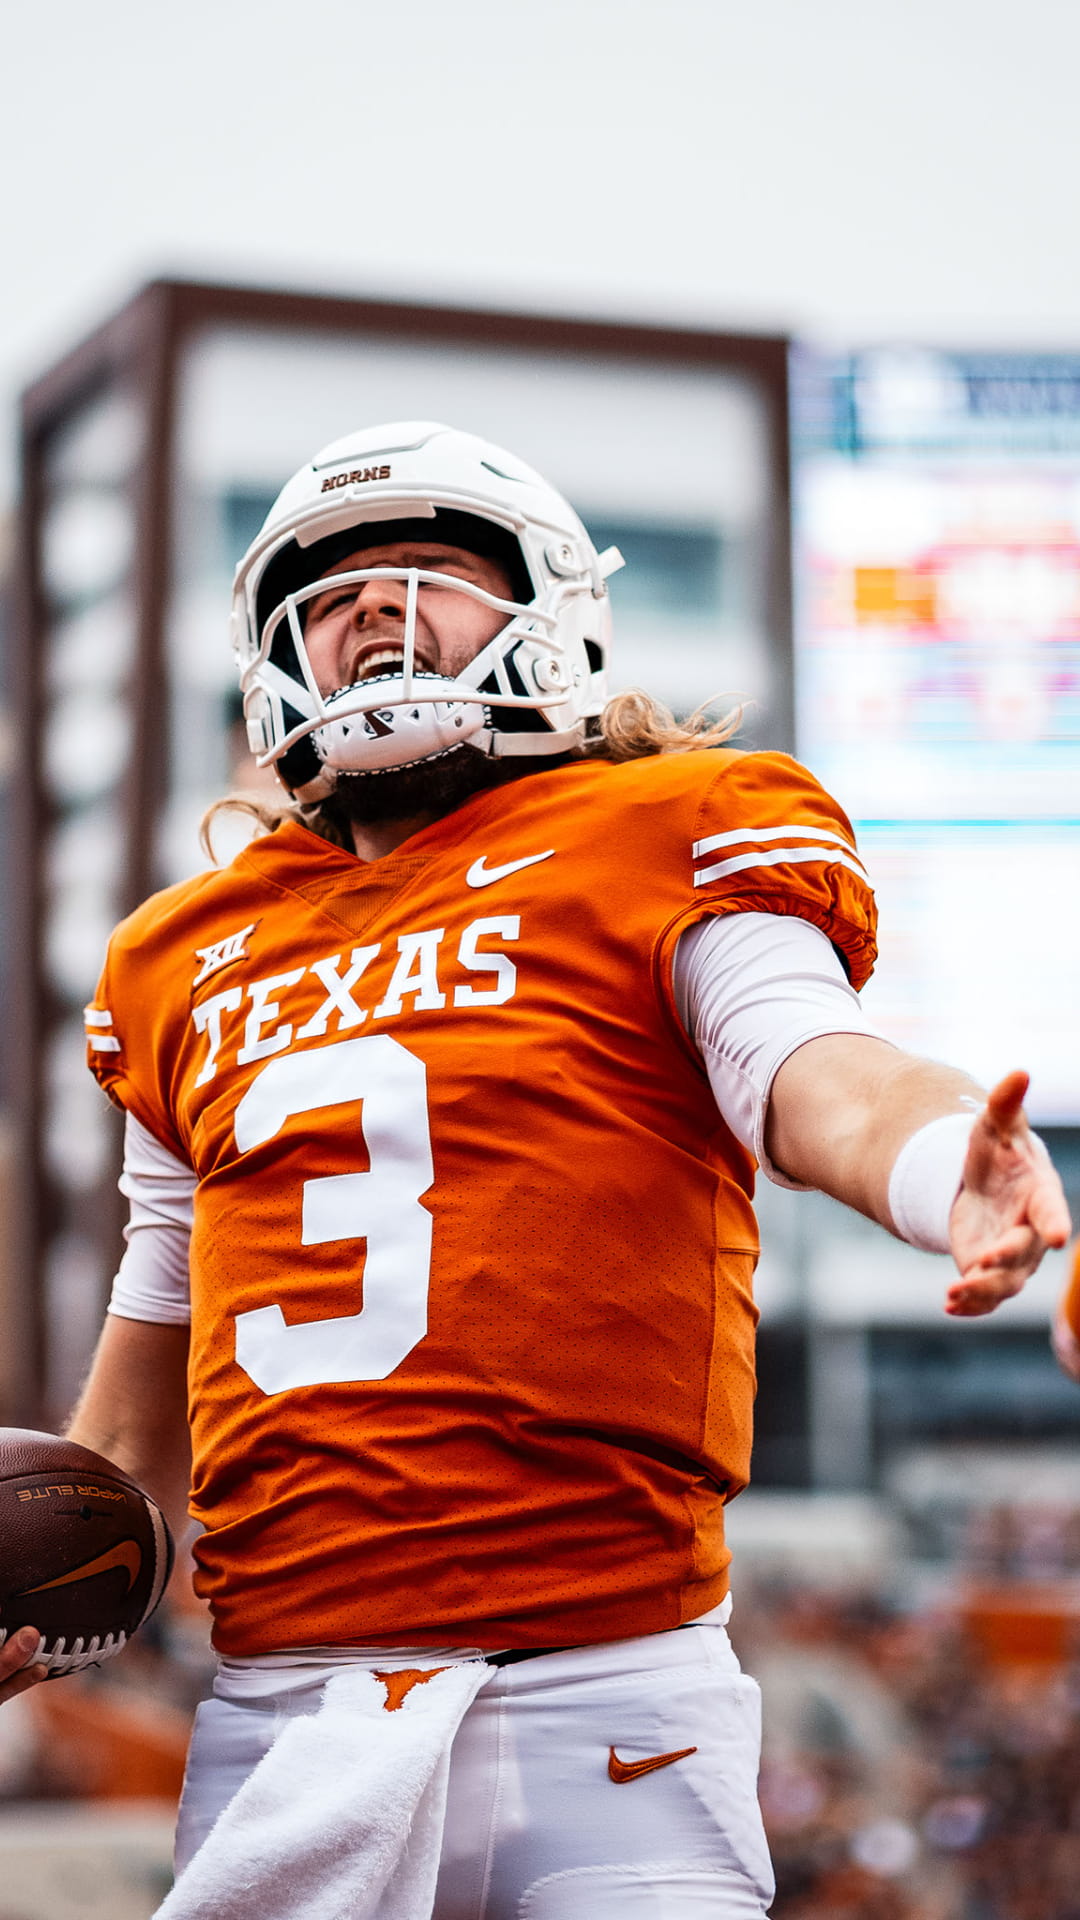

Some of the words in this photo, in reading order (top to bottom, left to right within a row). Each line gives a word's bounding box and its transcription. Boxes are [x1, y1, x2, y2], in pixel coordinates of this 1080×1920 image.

[321, 465, 391, 493] HORNS
[192, 915, 521, 1089] TEXAS
[234, 1034, 434, 1395] 3
[16, 1485, 74, 1502] ELITE
[75, 1485, 127, 1504] VAPOR
